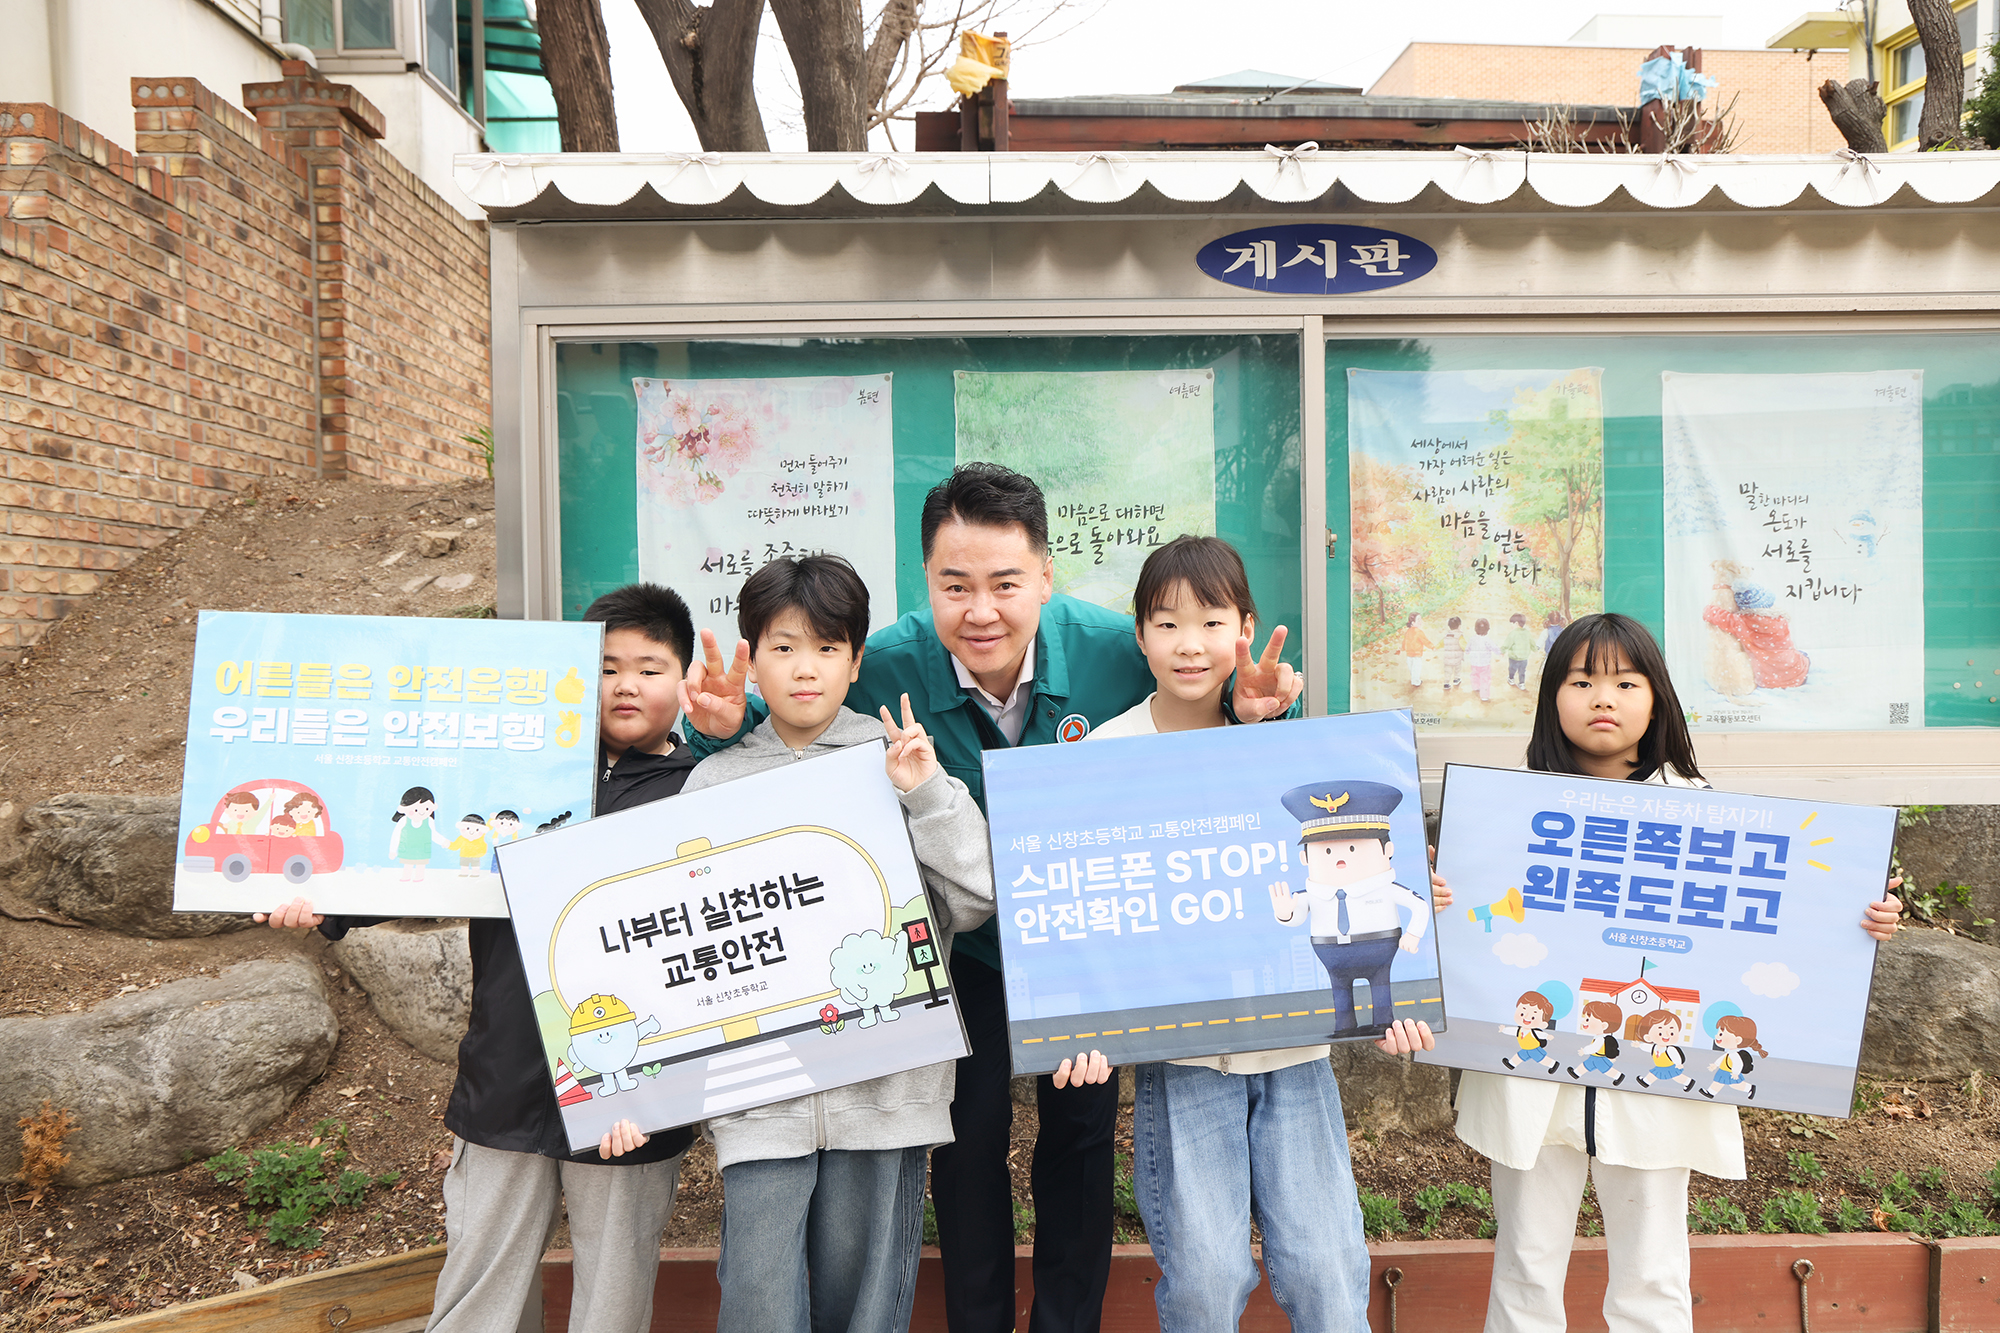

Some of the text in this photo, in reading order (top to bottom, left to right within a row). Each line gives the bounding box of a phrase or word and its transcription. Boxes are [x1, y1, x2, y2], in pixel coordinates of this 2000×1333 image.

[1224, 239, 1411, 280] 게시판
[857, 389, 880, 405] 봄편
[1169, 382, 1201, 399] 여름편
[1555, 382, 1591, 400] 가을편
[1874, 385, 1908, 402] 겨울편
[1410, 437, 1468, 455] 세상에서
[780, 454, 848, 475] 먼저 들어주기
[1419, 450, 1515, 476] 가장 어려운 일은
[771, 480, 848, 498] 천천히 말하기
[1412, 473, 1510, 505] 사람이 사람의
[747, 504, 849, 525] 따뜻하게 바라보기
[1057, 503, 1166, 527] 마음으로 대하면
[1440, 509, 1491, 541] 마음을
[1762, 508, 1808, 533] 온도가
[1089, 525, 1167, 565] 돌아와요
[1493, 528, 1526, 554] 얻는
[1471, 554, 1542, 585] 일이란다
[1761, 538, 1812, 574] 서로를
[1785, 577, 1863, 605] 지킵니다
[214, 659, 549, 706] 어른들은 안전운행
[208, 705, 547, 752] 우리들은 안전보행
[314, 753, 457, 767] 서울 신창초등학교 교통안전캠페인
[1557, 788, 1774, 829] 우리눈은 자동차 탐지기!
[1009, 812, 1263, 854] 서울 신창초등학교 교통안전캠페인
[1527, 810, 1791, 881] 오른쪽보고
[1011, 839, 1291, 901] 스마트폰 STOP!
[598, 872, 826, 954] 나부터 실천하는
[1521, 864, 1783, 936] 왼쪽도보고
[1013, 887, 1246, 945] 안전확인 GO!
[1608, 932, 1687, 950] 서울 신창초등학교
[661, 925, 788, 990] 교통안전
[696, 980, 769, 1006] 서울 신창초등학교
